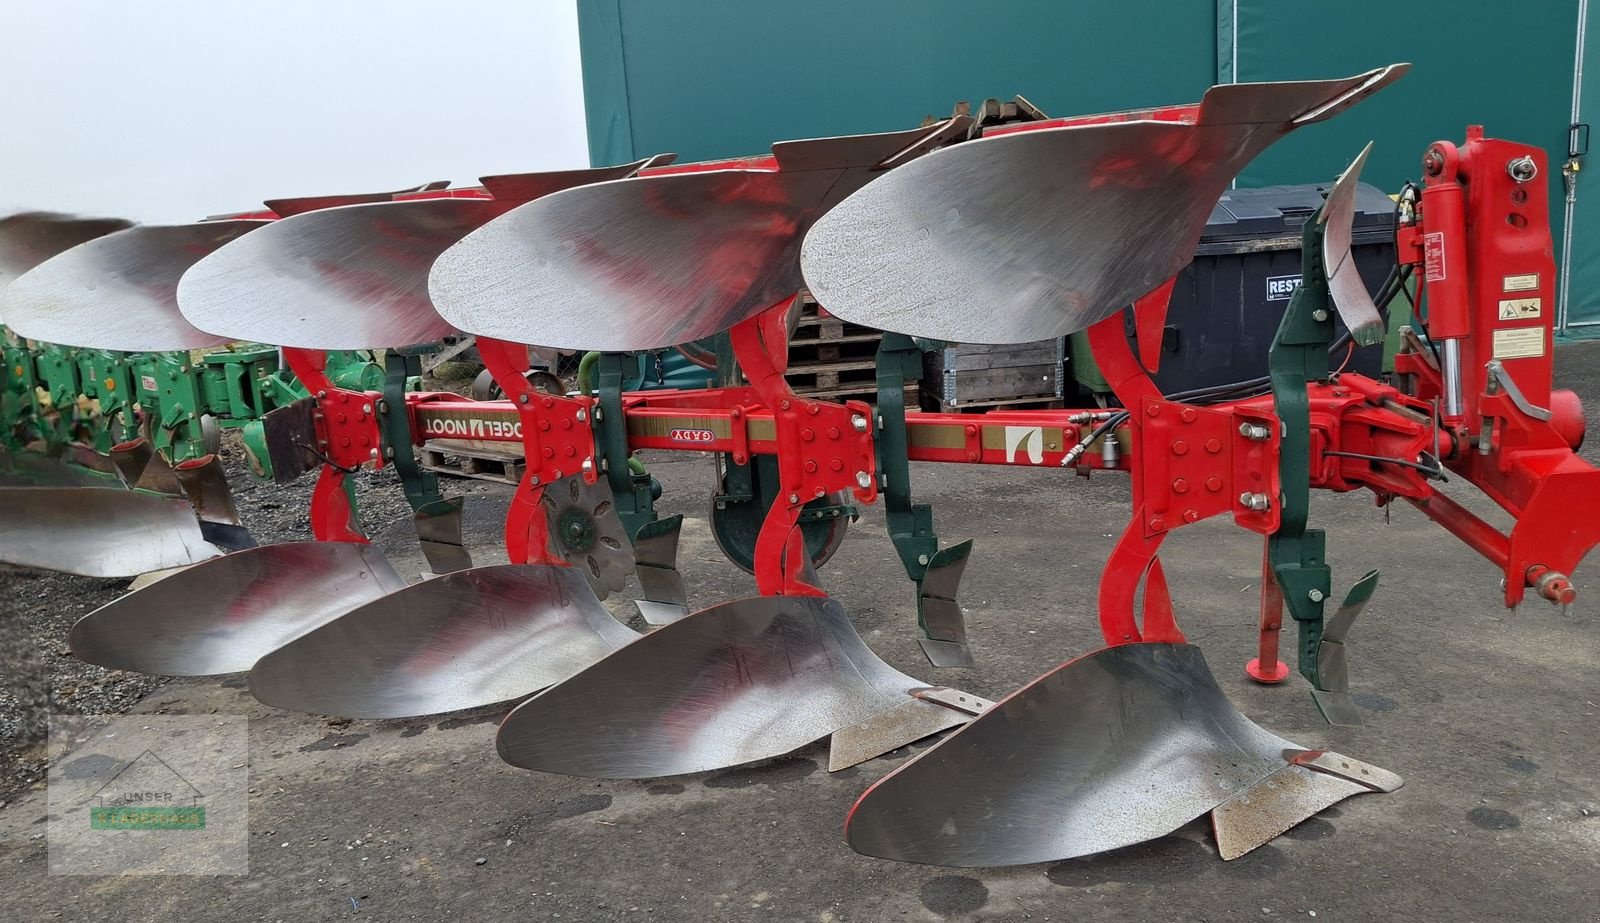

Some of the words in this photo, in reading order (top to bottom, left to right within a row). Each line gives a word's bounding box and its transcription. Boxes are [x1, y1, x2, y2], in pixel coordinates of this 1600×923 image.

[1269, 279, 1303, 293] REST
[426, 419, 467, 435] NOOT
[675, 430, 711, 441] GADY
